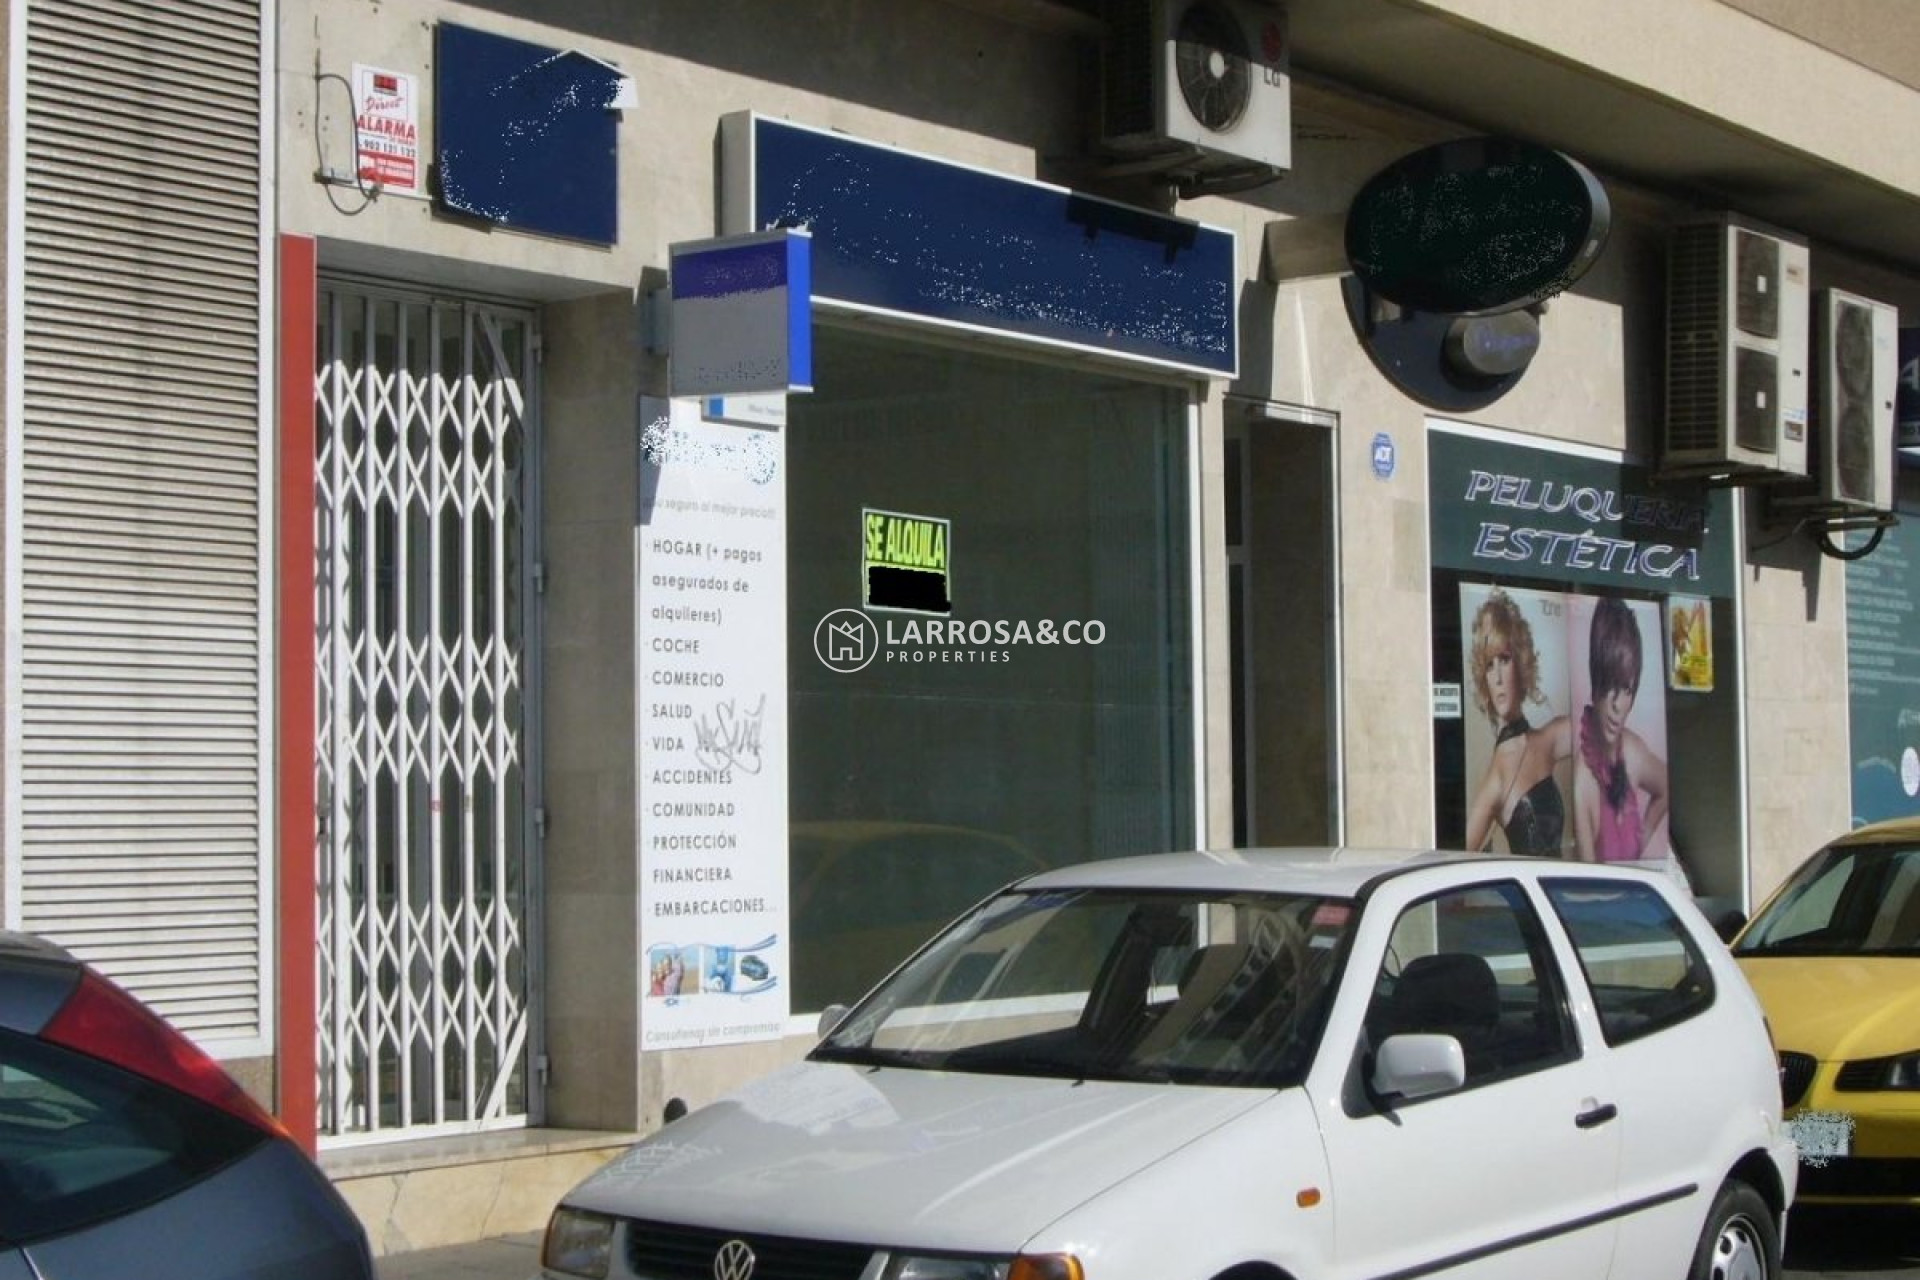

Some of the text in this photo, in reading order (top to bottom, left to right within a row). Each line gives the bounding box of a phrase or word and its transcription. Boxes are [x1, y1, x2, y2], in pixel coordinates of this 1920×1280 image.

[357, 114, 415, 139] ALARMA
[865, 514, 945, 568] SE ALQUILA
[652, 539, 702, 557] HOGAR
[723, 548, 762, 563] pagos
[1473, 522, 1700, 580] ESTÉTICA
[652, 575, 750, 593] asegurados de
[652, 605, 722, 625] alquileres)
[652, 637, 700, 654] COCHE
[652, 670, 724, 687] COMERCIO
[652, 703, 692, 719] SALUD
[652, 736, 684, 751] VIDA
[652, 768, 732, 785] ACCIDENTES
[652, 802, 735, 817] COMUNIDAD
[652, 830, 737, 851] PROTECCIÓN
[653, 866, 732, 884] FINANCIERA
